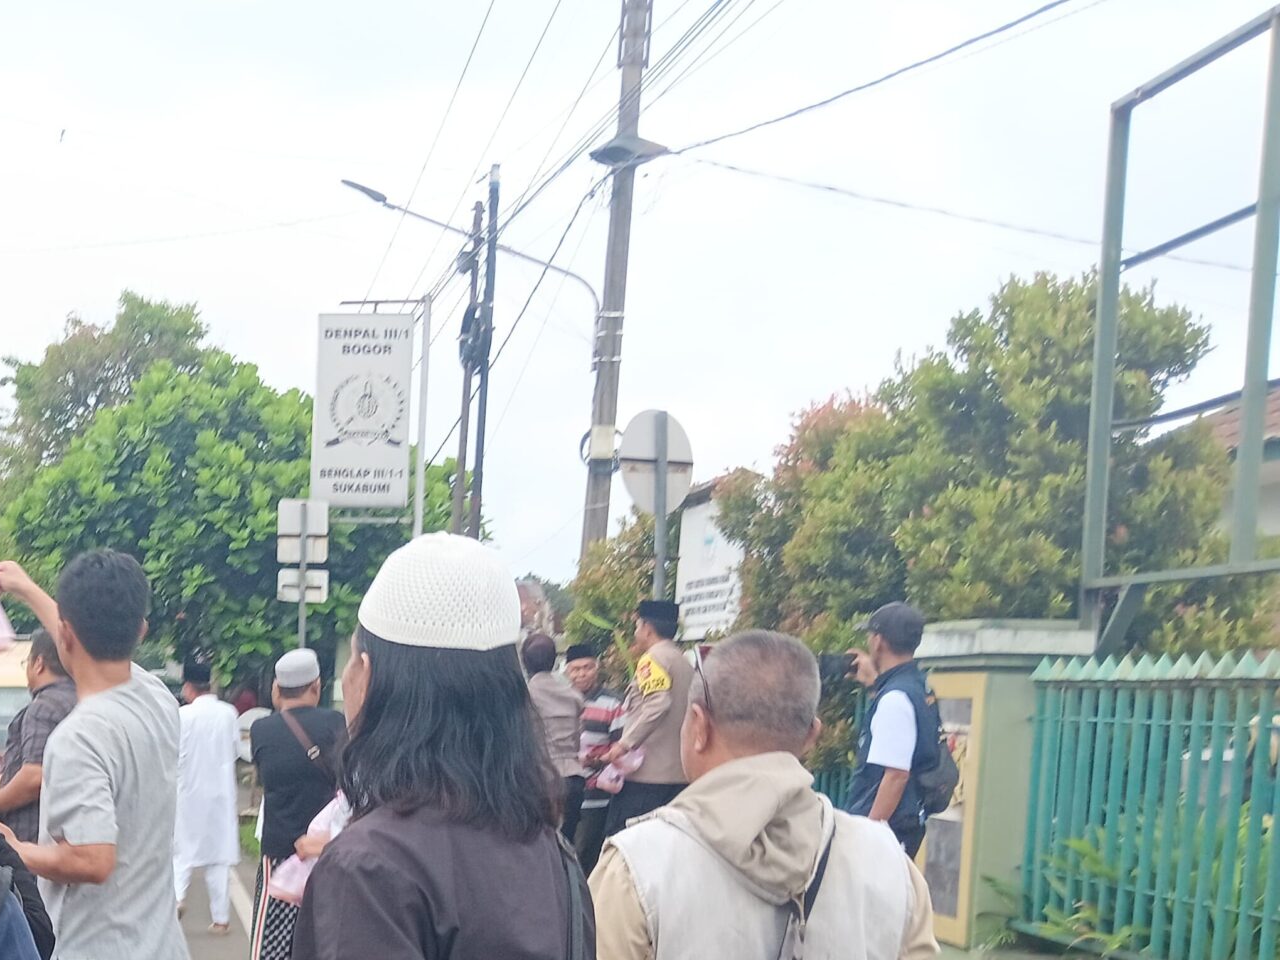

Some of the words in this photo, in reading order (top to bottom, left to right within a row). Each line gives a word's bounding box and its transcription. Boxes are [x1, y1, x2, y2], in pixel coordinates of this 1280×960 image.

[324, 328, 379, 340] DENPAL
[383, 328, 410, 340] III/1
[341, 344, 392, 355] BOGOR
[319, 468, 371, 479] BENGLAP
[331, 483, 391, 494] SUKABUMI
